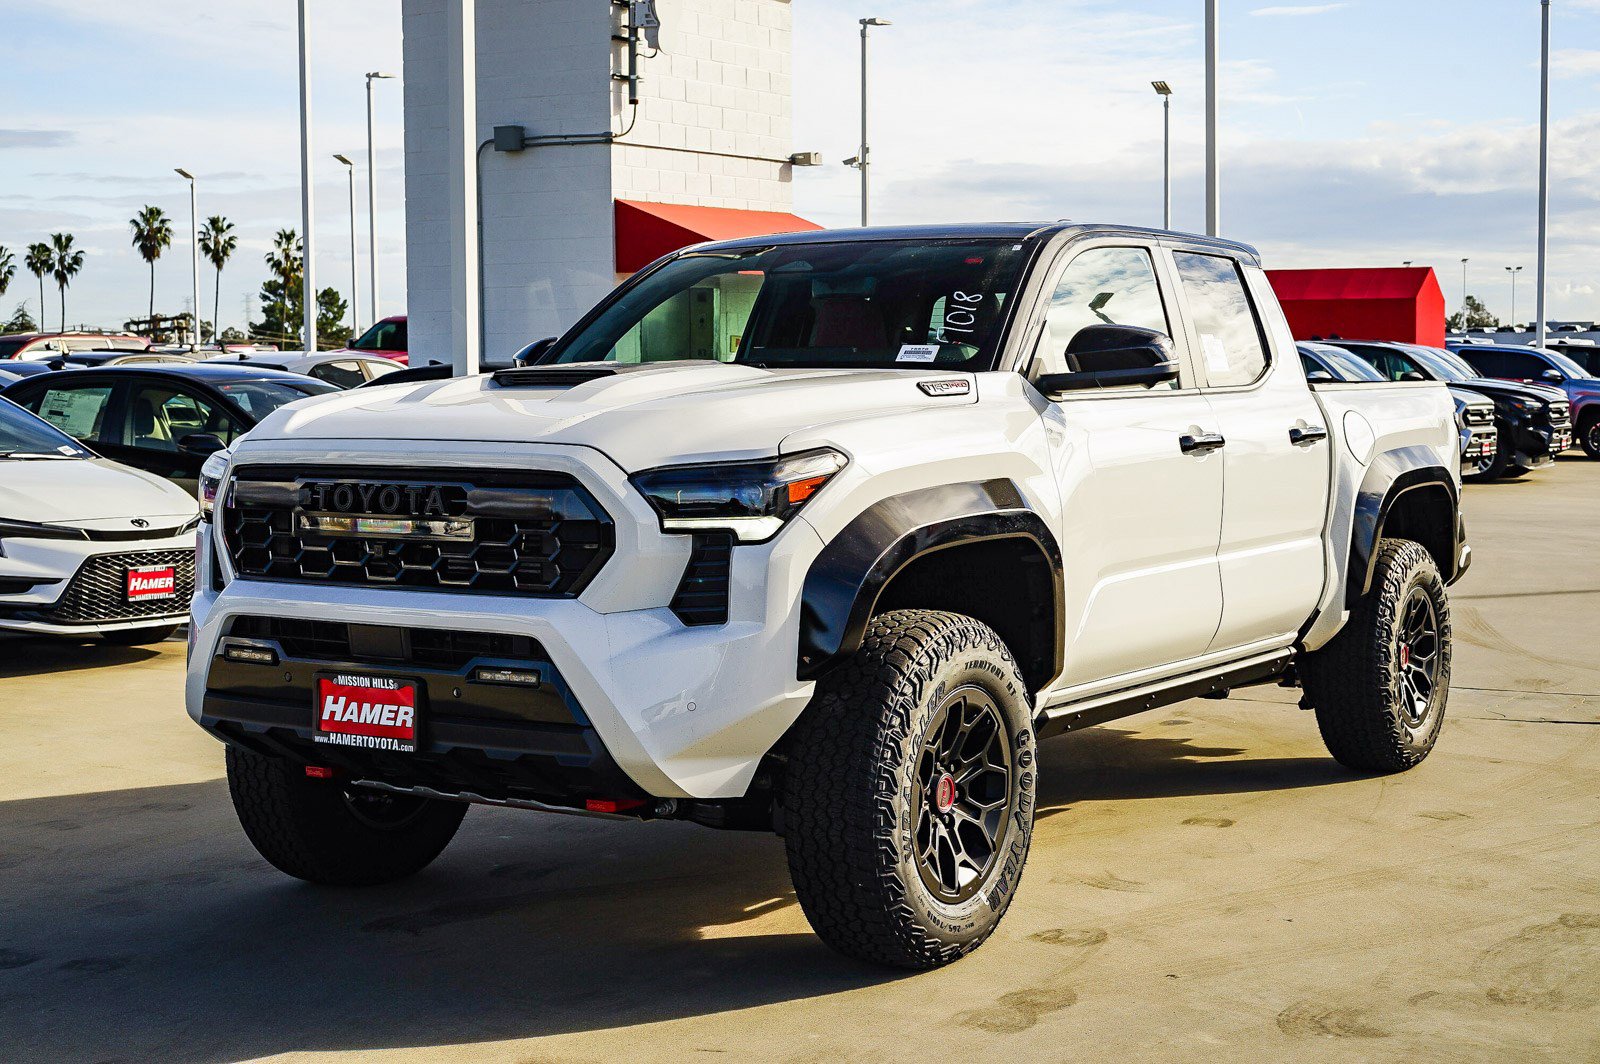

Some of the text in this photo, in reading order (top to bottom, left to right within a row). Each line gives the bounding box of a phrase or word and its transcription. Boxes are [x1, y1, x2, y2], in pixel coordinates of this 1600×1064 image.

[315, 483, 449, 516] TOYOTA
[129, 577, 174, 592] HAMER
[964, 660, 1006, 681] TERRITORY
[337, 675, 394, 690] MISSION HILLS
[322, 695, 415, 728] HAMER
[314, 732, 414, 753] www.HAMERTOYOTA.com
